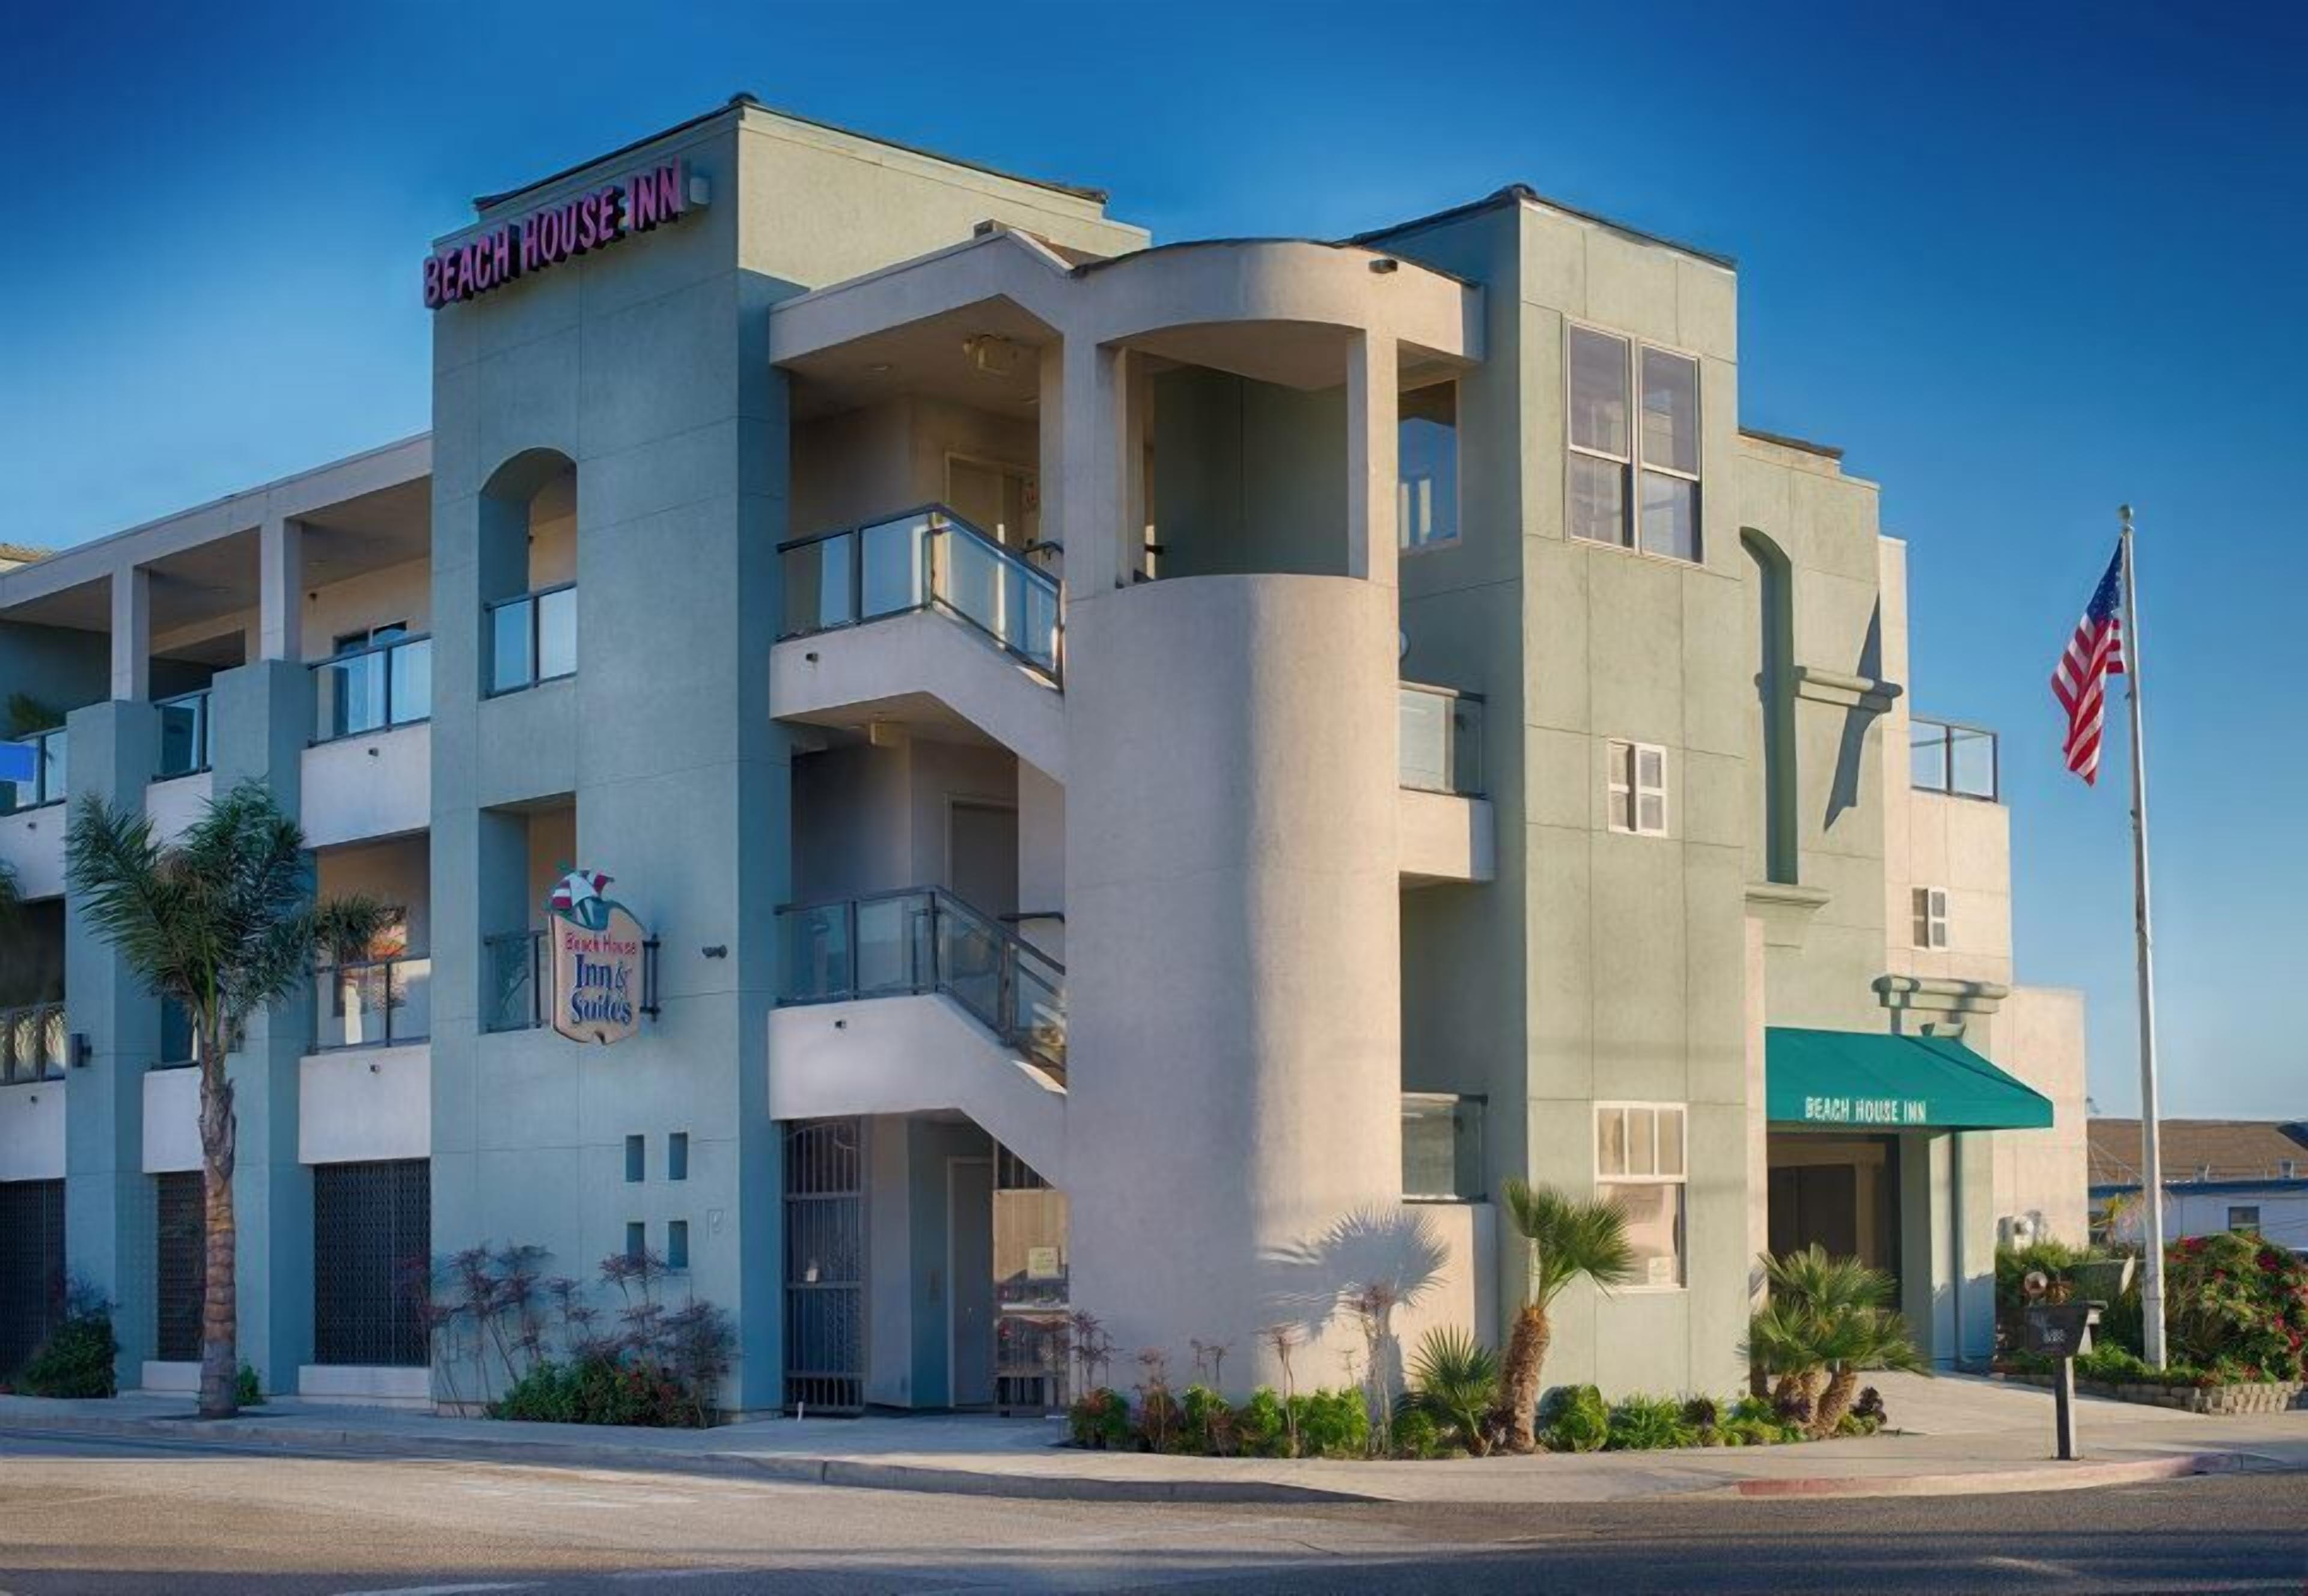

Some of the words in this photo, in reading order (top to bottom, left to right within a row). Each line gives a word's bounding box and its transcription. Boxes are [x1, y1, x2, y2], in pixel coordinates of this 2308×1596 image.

[423, 221, 516, 308] BEACH
[519, 186, 620, 272] HOUSE
[627, 154, 683, 231] INN
[566, 931, 599, 952] Beach
[603, 932, 635, 955] House
[575, 954, 612, 989] Inn
[572, 989, 632, 1025] Suites
[1805, 1096, 1849, 1121] BEACH
[1855, 1099, 1899, 1122] HOUSE
[1903, 1100, 1926, 1124] INN
